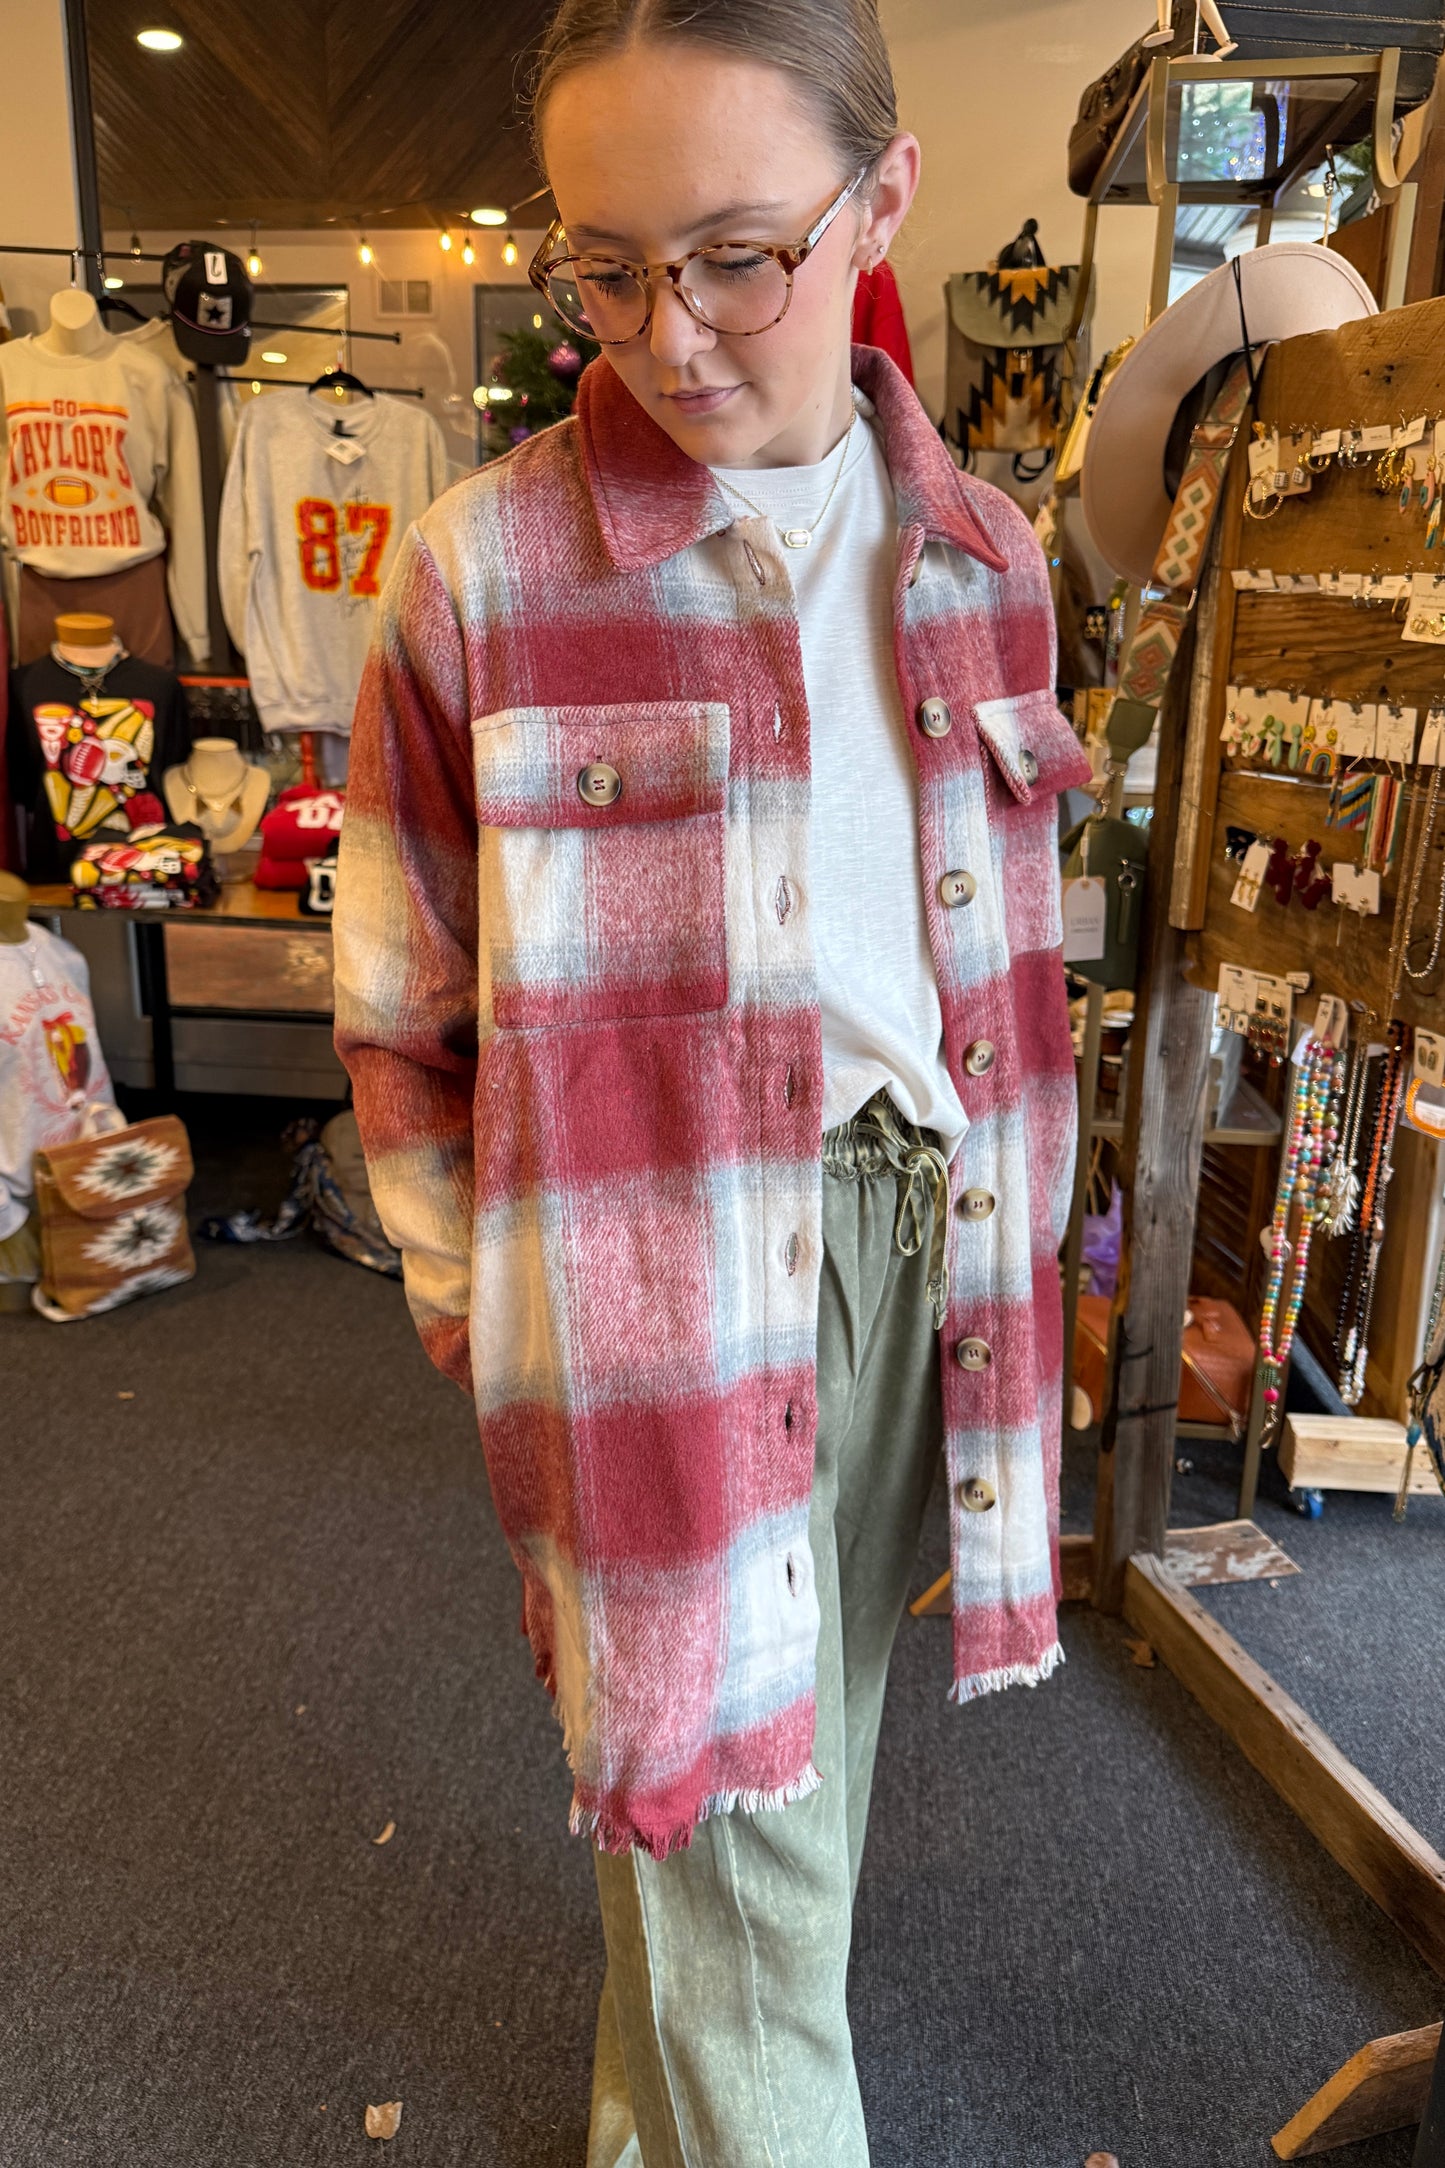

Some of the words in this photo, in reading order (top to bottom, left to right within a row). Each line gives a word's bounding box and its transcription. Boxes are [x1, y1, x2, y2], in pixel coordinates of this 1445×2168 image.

[53, 399, 78, 417] GO
[9, 421, 132, 490] TAYLOR'S
[11, 503, 142, 548] BOYFRIEND
[294, 496, 393, 599] 87
